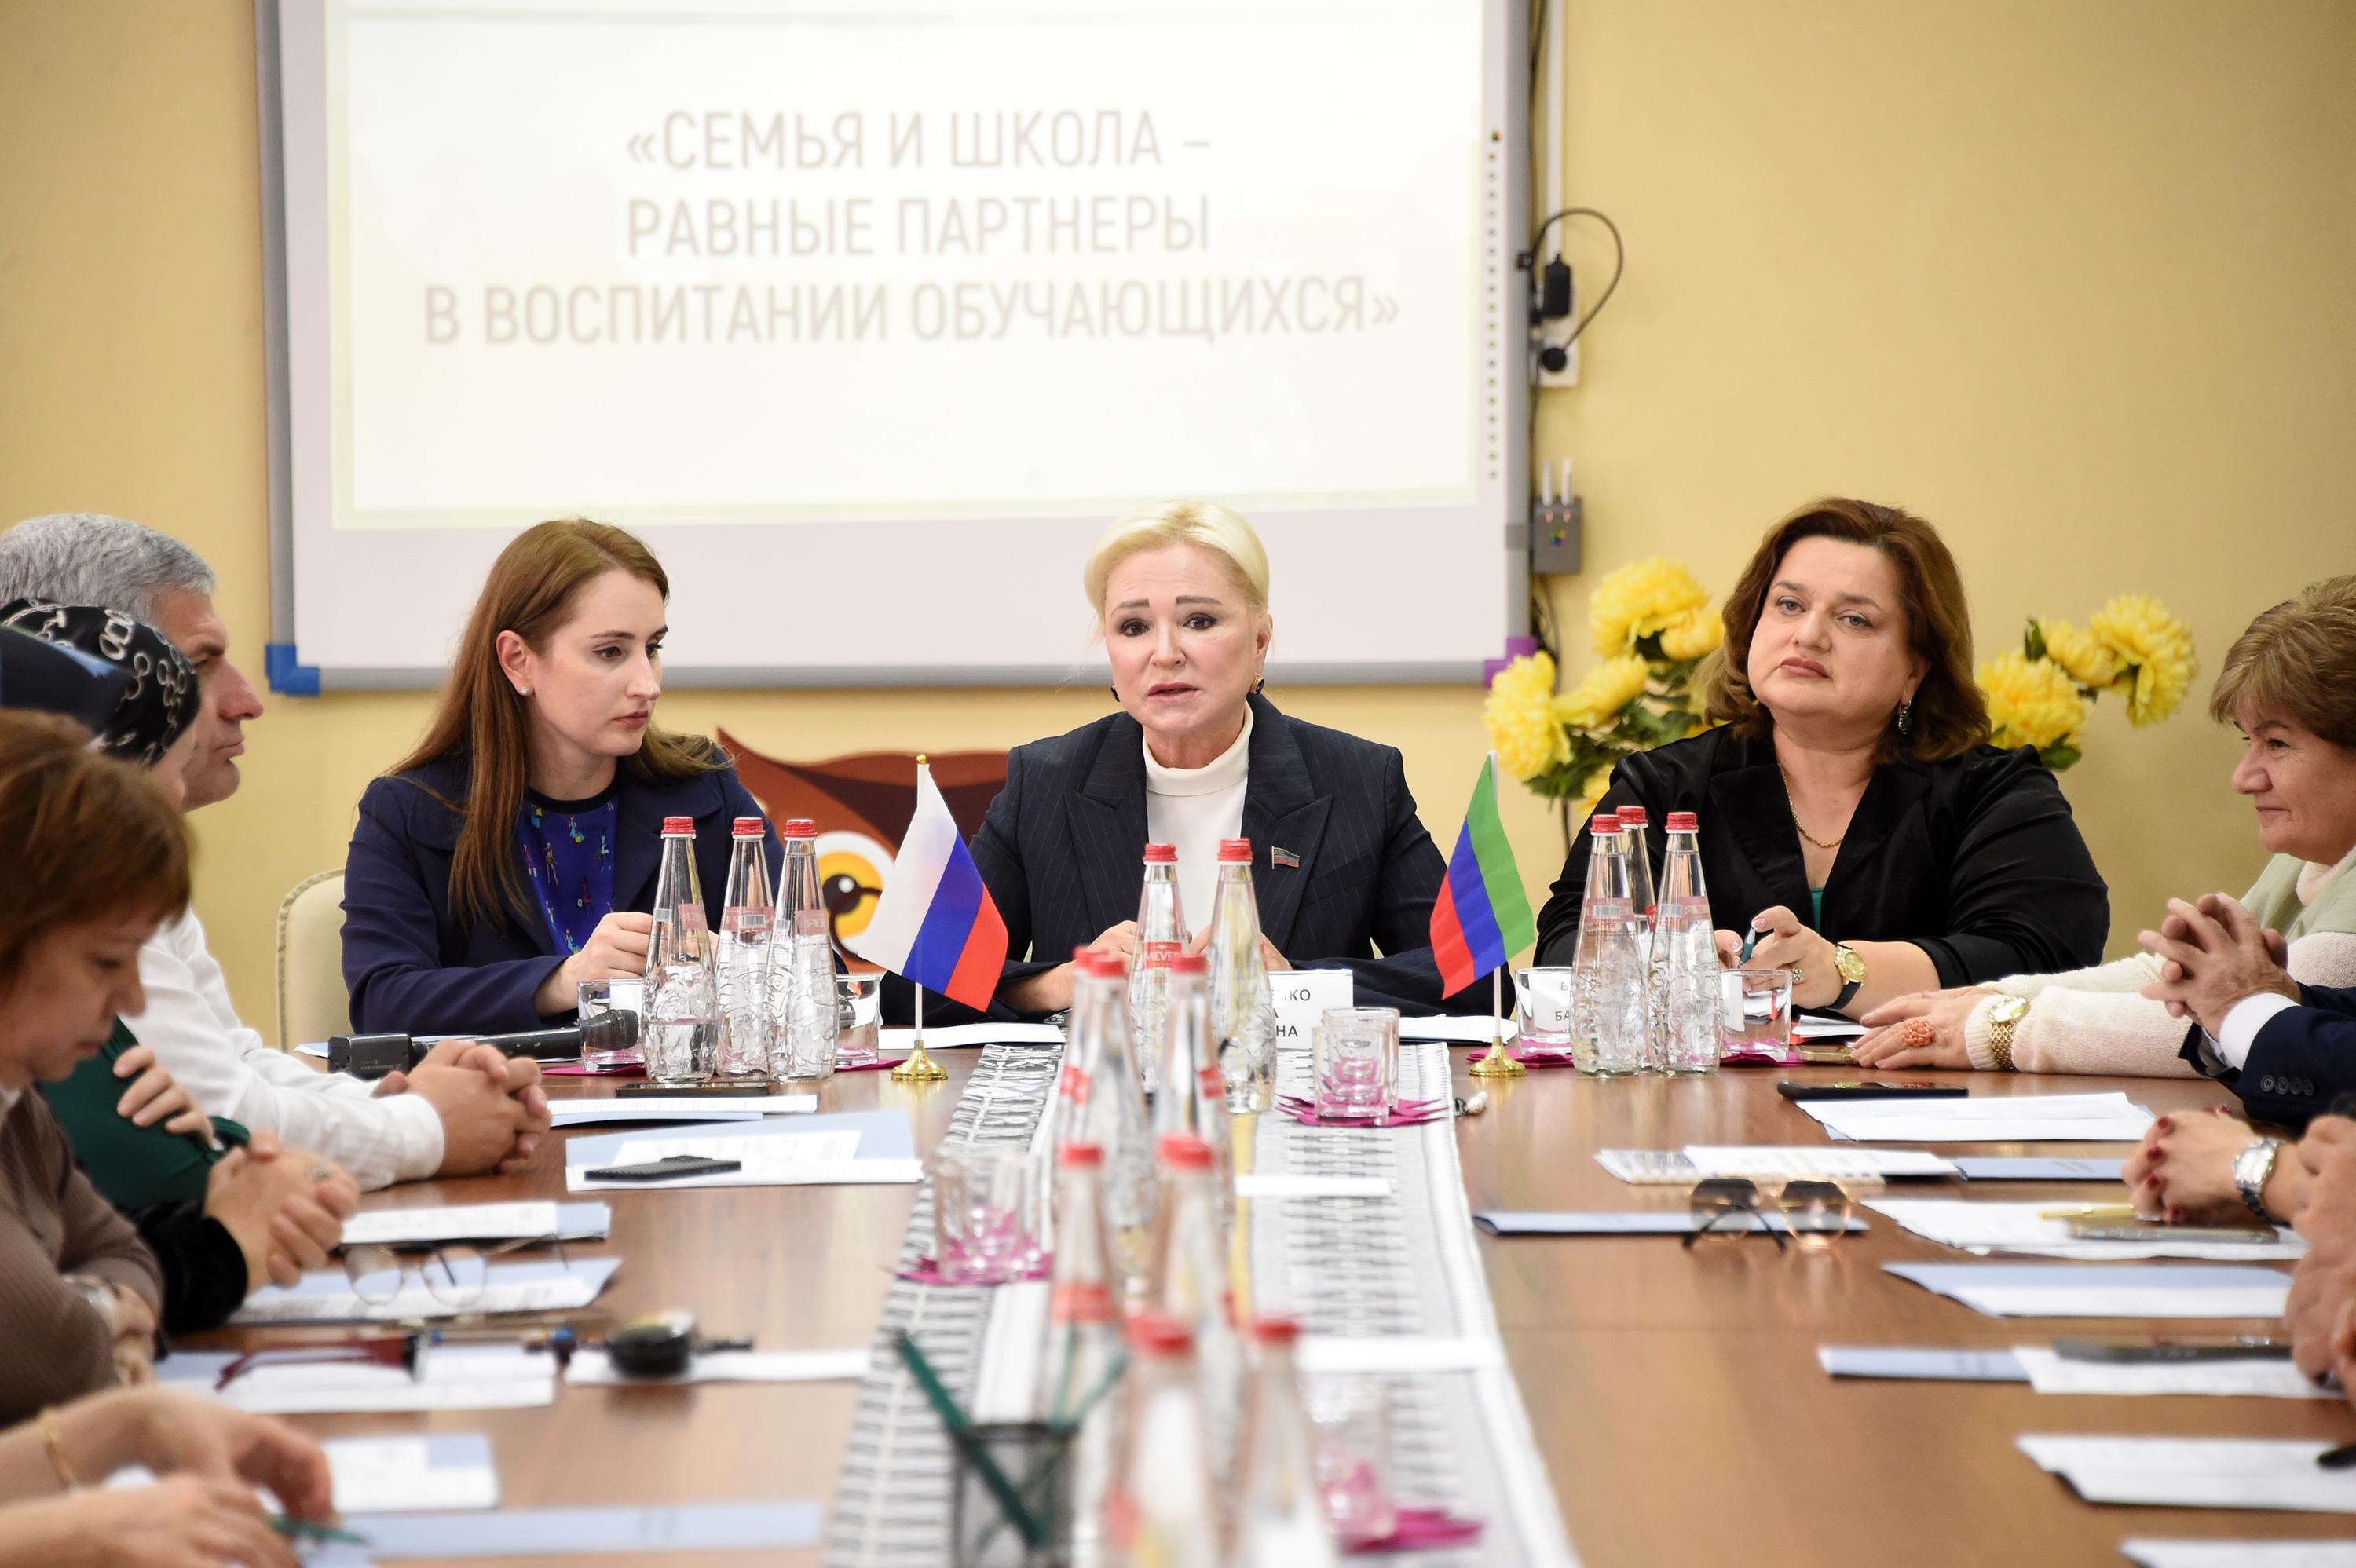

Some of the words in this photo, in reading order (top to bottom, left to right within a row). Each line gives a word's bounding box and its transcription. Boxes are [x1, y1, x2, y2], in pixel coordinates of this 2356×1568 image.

[626, 110, 864, 171] «СЕМЬЯ
[889, 111, 924, 170] И
[950, 109, 1162, 168] ШКОЛА
[627, 197, 873, 258] РАВНЫЕ
[898, 195, 1209, 255] ПАРТНЕРЫ
[425, 284, 460, 345] В
[485, 283, 887, 345] ВОСПИТАНИИ
[911, 275, 1399, 344] ОБУЧАЮЩИХСЯ»
